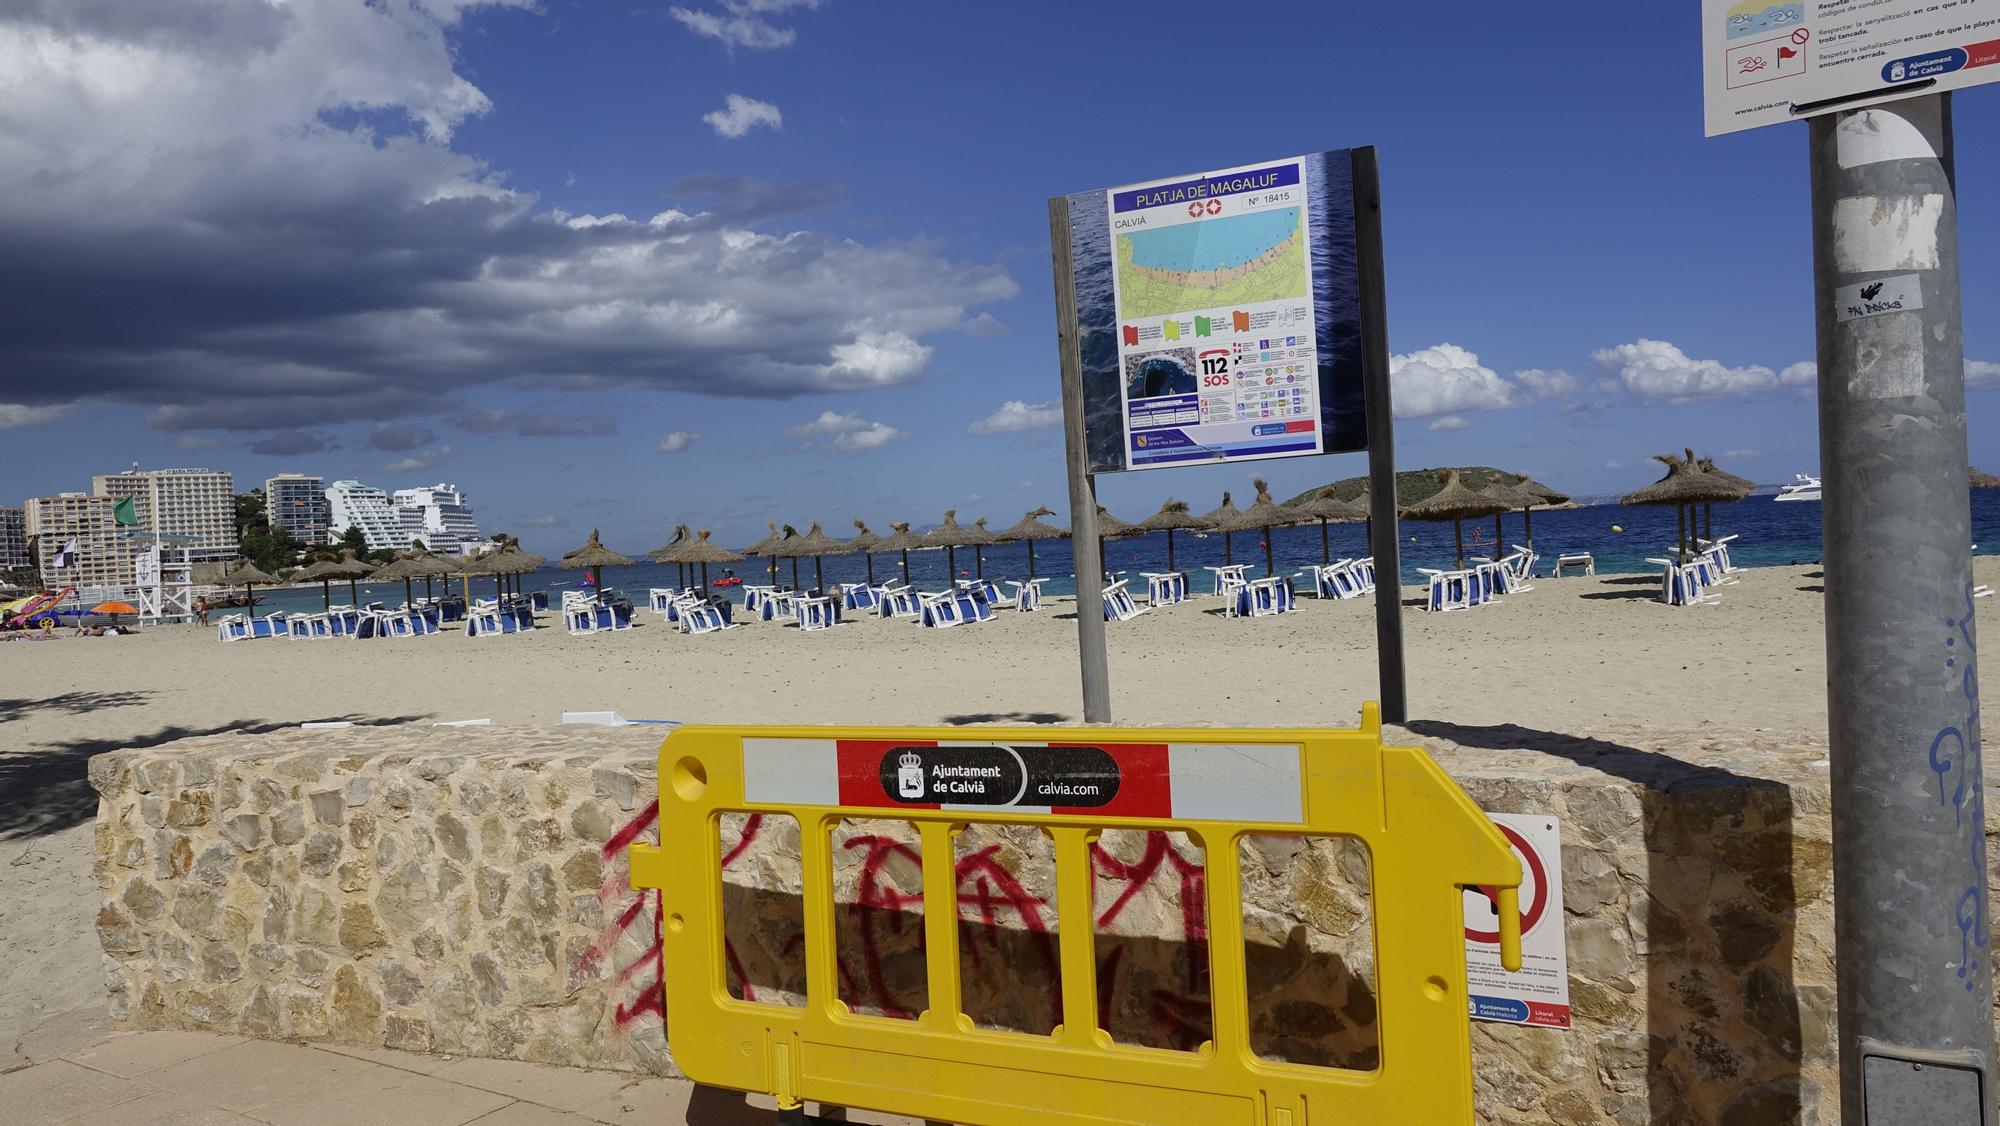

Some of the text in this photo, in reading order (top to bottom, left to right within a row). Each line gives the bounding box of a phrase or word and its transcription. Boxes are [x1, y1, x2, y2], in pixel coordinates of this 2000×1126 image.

[1817, 8, 1846, 19] códigos
[1847, 4, 1857, 12] de
[1818, 24, 1853, 36] Respectar
[1865, 10, 1911, 25] senyalització
[1942, 1, 1957, 9] que
[1818, 28, 1869, 44] trobi tancada.
[1818, 49, 1850, 61] Respetar
[1859, 38, 1902, 52] señalización
[1915, 32, 1933, 40] caso
[1947, 26, 1962, 34] que
[1973, 18, 1995, 29] playa
[1818, 50, 1888, 69] encuentre cerrada.
[1909, 56, 1953, 70] Ajuntament
[1975, 54, 1997, 63] Litoral
[1909, 65, 1944, 77] de Calvià
[1735, 100, 1789, 115] www.calvia.com
[1136, 173, 1279, 207] PLATJA DE MAGALUF
[1264, 192, 1290, 203] 18415
[1202, 357, 1228, 375] 112
[1203, 374, 1230, 387] SOS
[932, 764, 1001, 779] Ajuntament
[933, 780, 985, 794] de Calvià
[1038, 782, 1099, 796] calvia.com
[1480, 1004, 1510, 1012] Ajuntament
